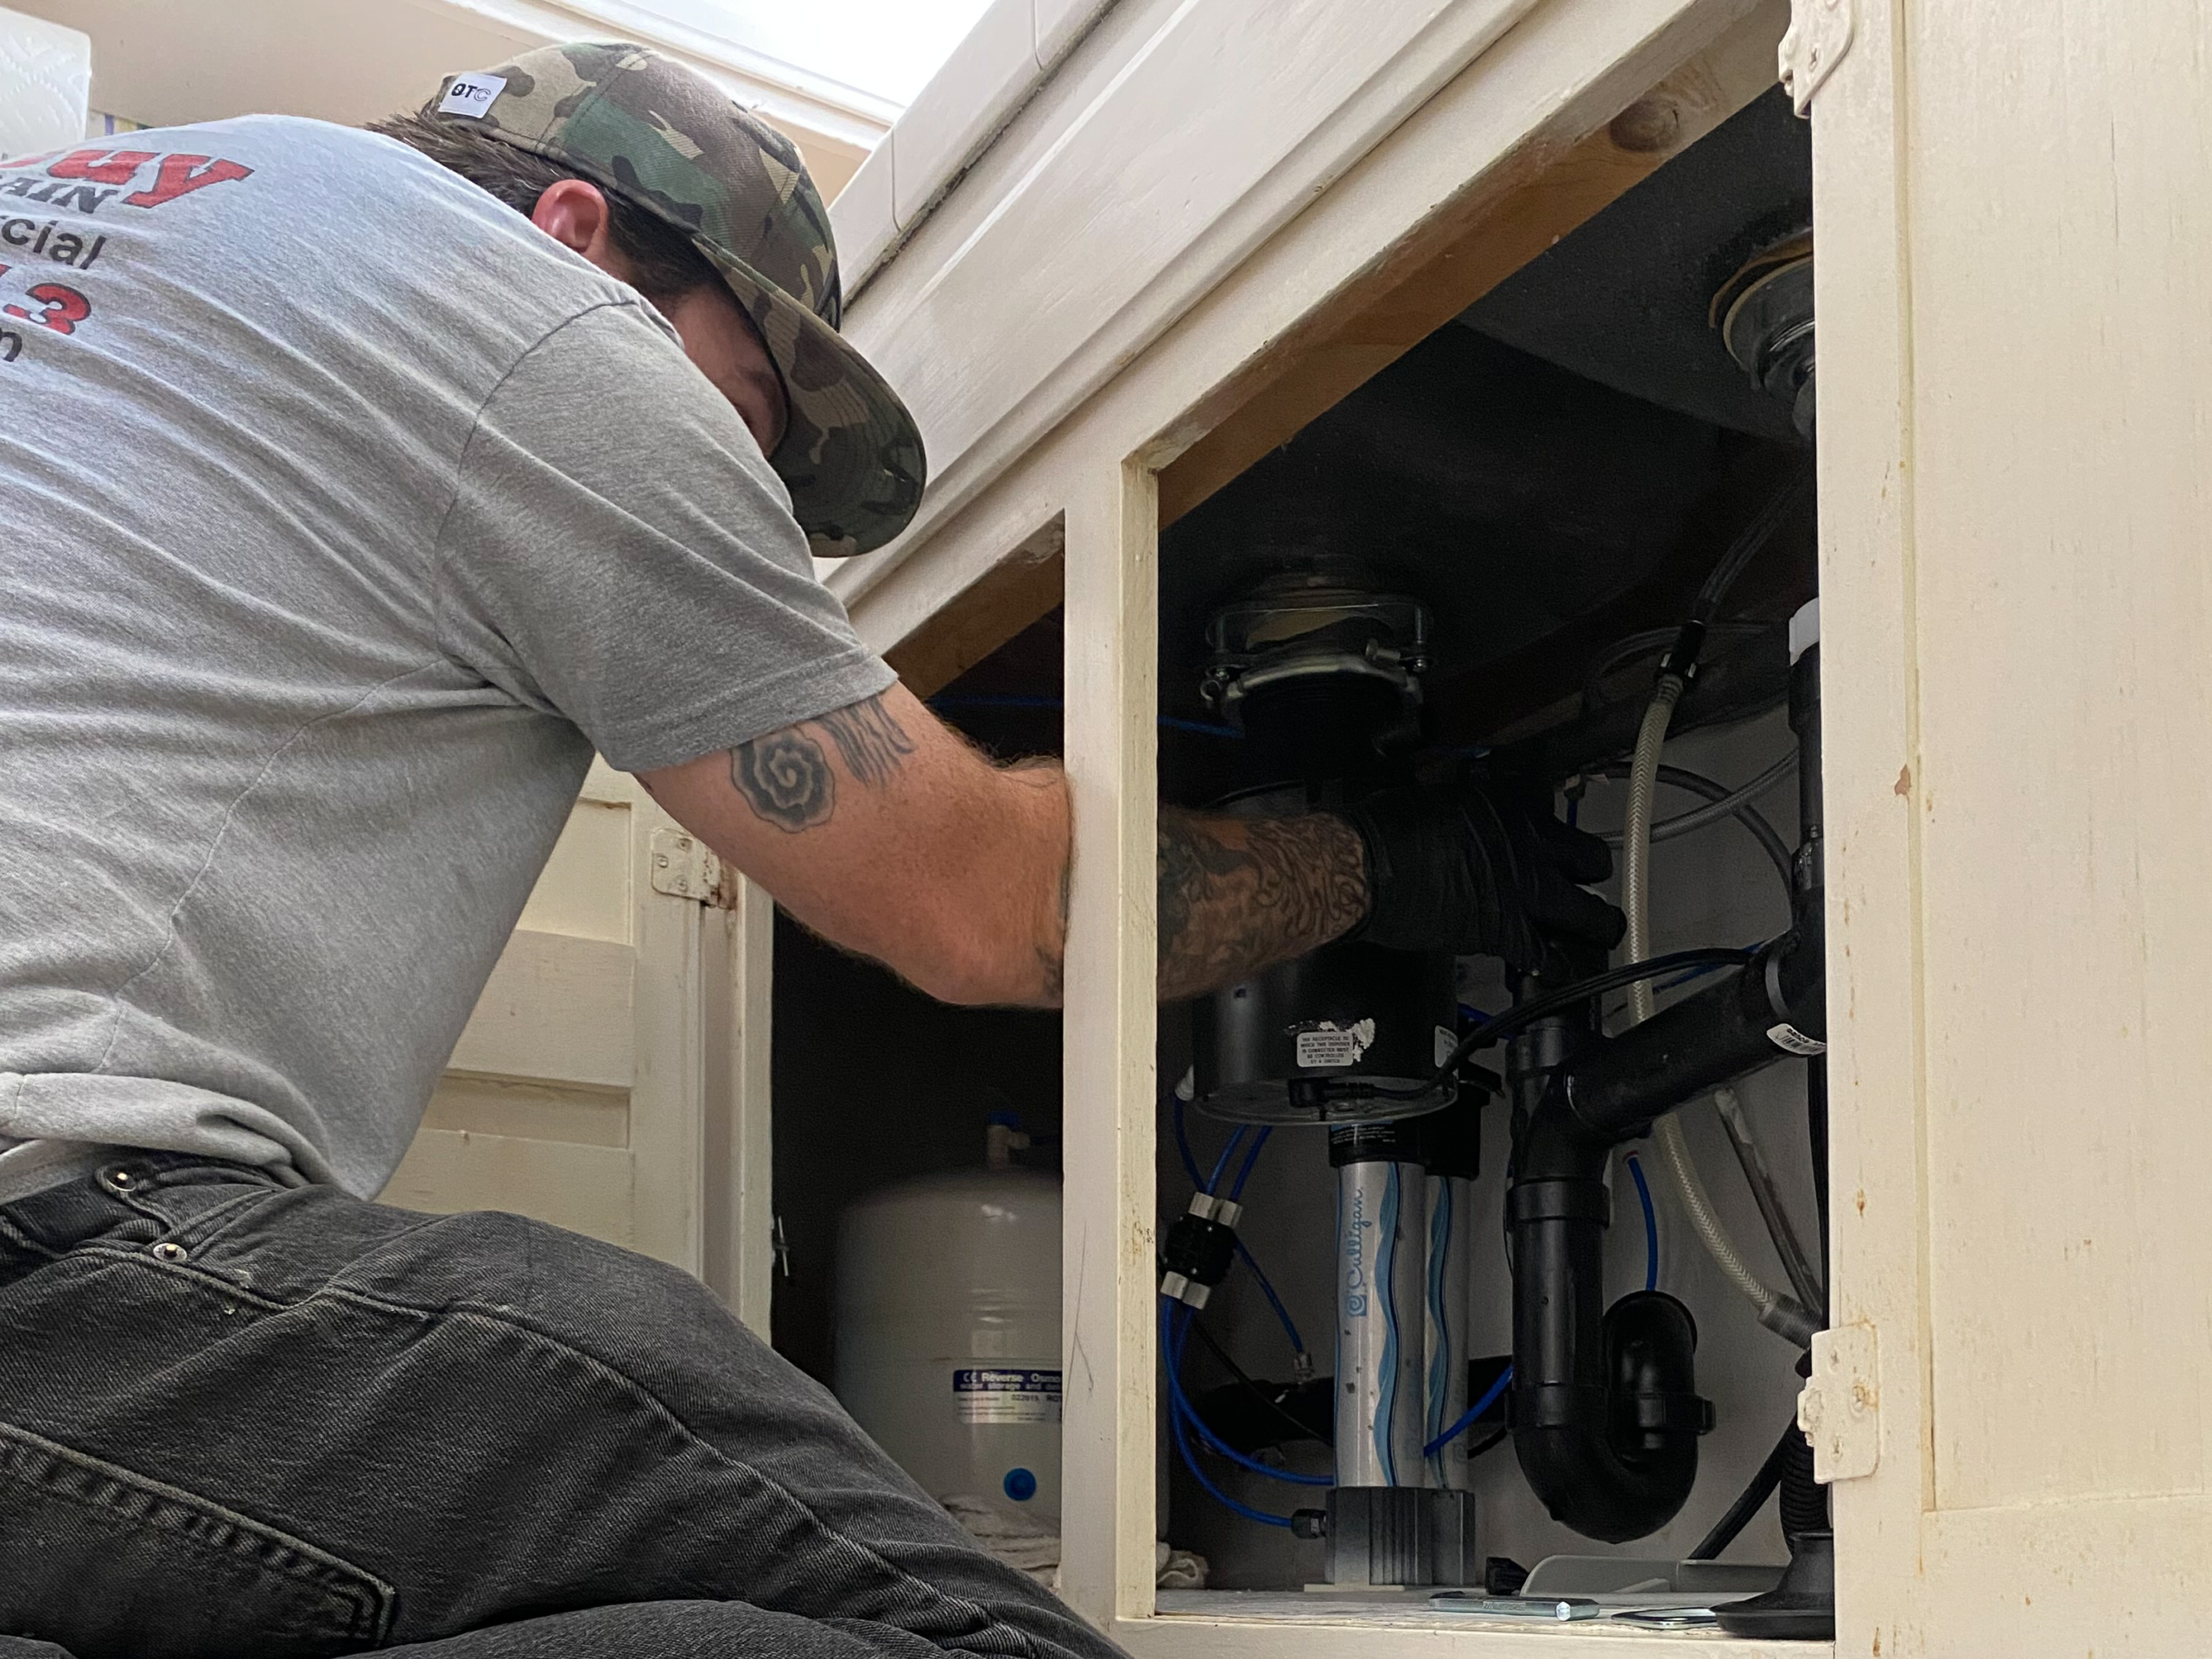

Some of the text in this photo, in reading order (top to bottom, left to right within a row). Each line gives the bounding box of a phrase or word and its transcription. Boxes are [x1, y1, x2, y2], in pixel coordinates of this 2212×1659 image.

[0, 149, 255, 208] uy
[0, 175, 119, 214] AIN
[0, 215, 107, 270] cial
[0, 264, 92, 334] 3
[1346, 1189, 1372, 1289] Culligan
[981, 1372, 1024, 1382] Reverse
[988, 1382, 1021, 1391] storage
